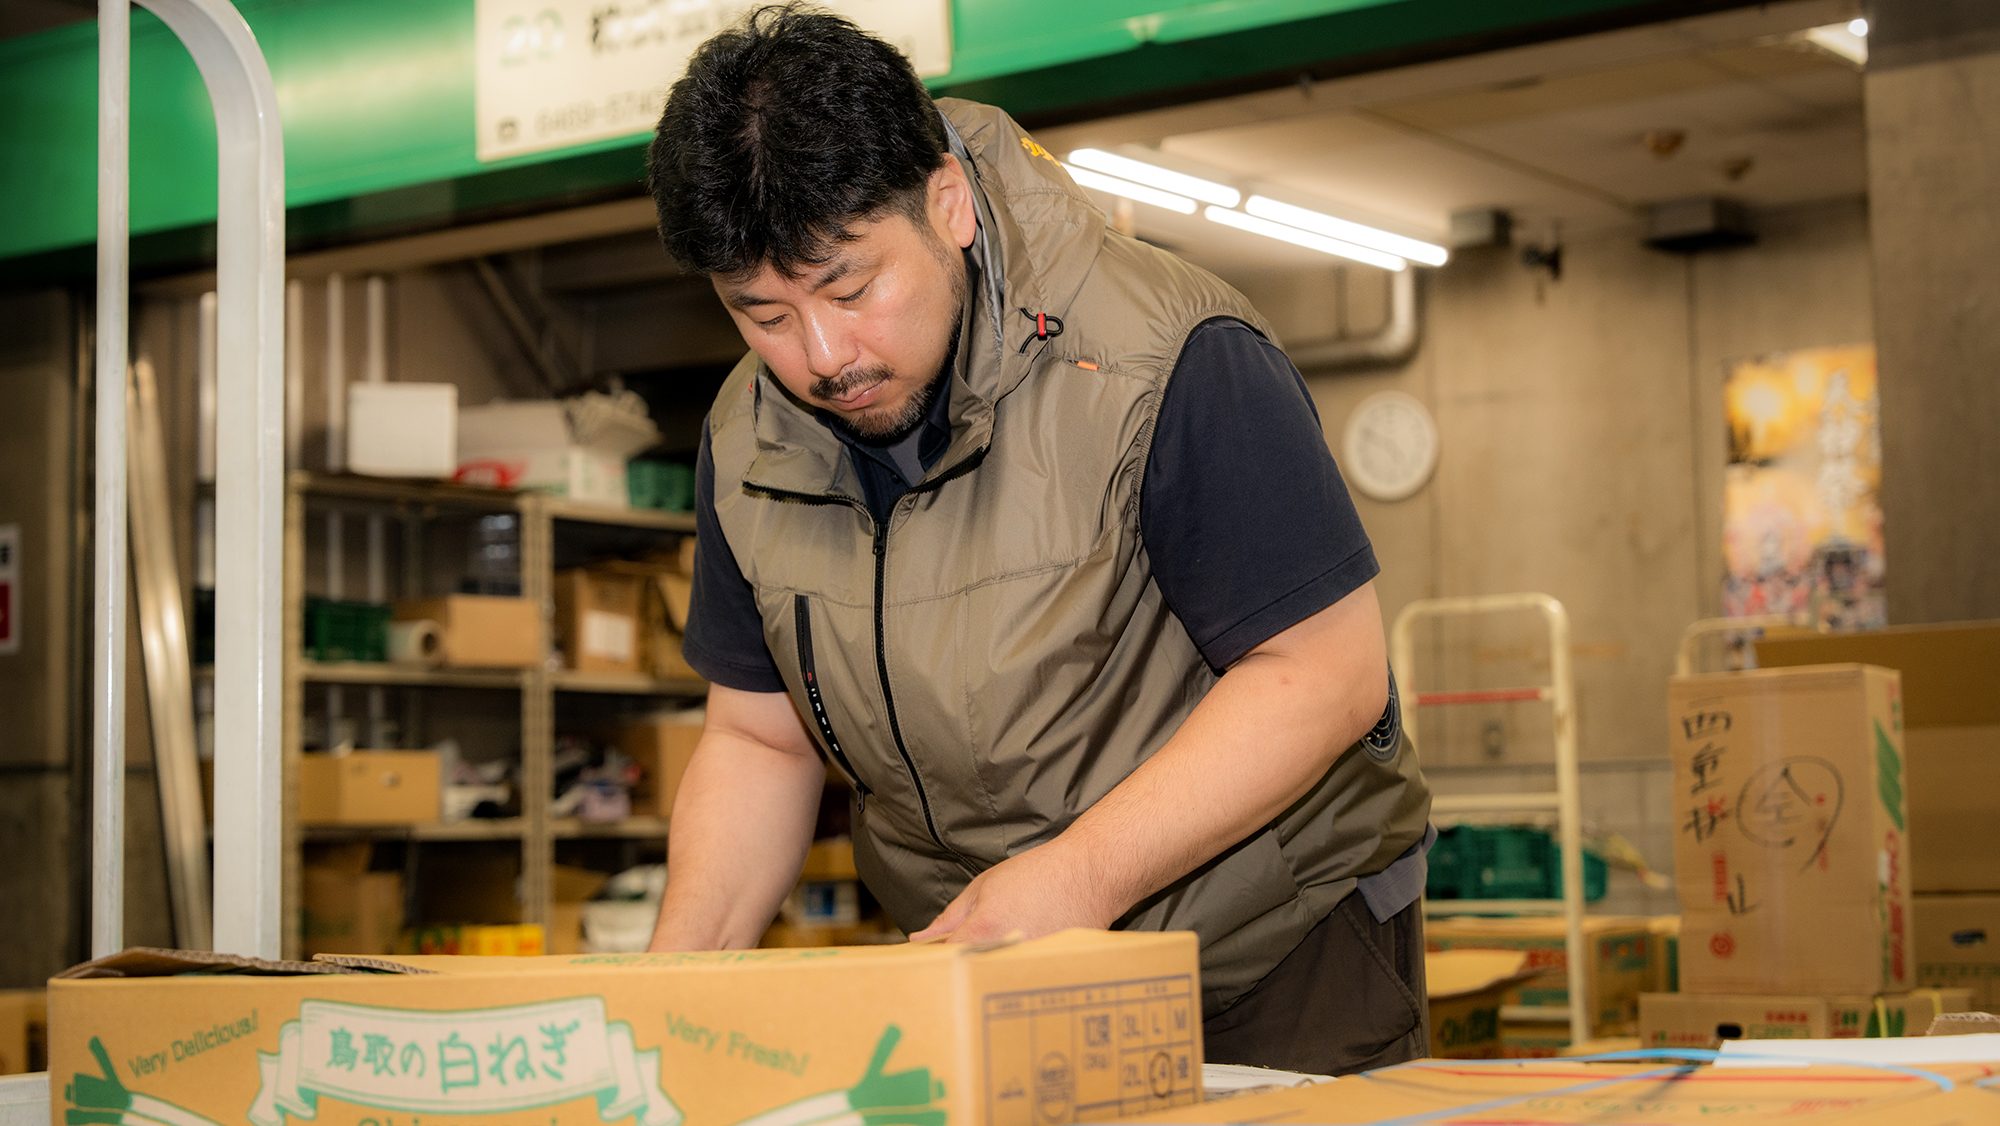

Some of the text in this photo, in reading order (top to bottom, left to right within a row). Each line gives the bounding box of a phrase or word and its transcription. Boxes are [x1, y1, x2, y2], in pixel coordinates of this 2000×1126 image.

[126, 1010, 259, 1079] Very Delicious!
[326, 1018, 581, 1095] 鳥取の白ねぎ
[664, 1011, 811, 1077] Very Fresh!
